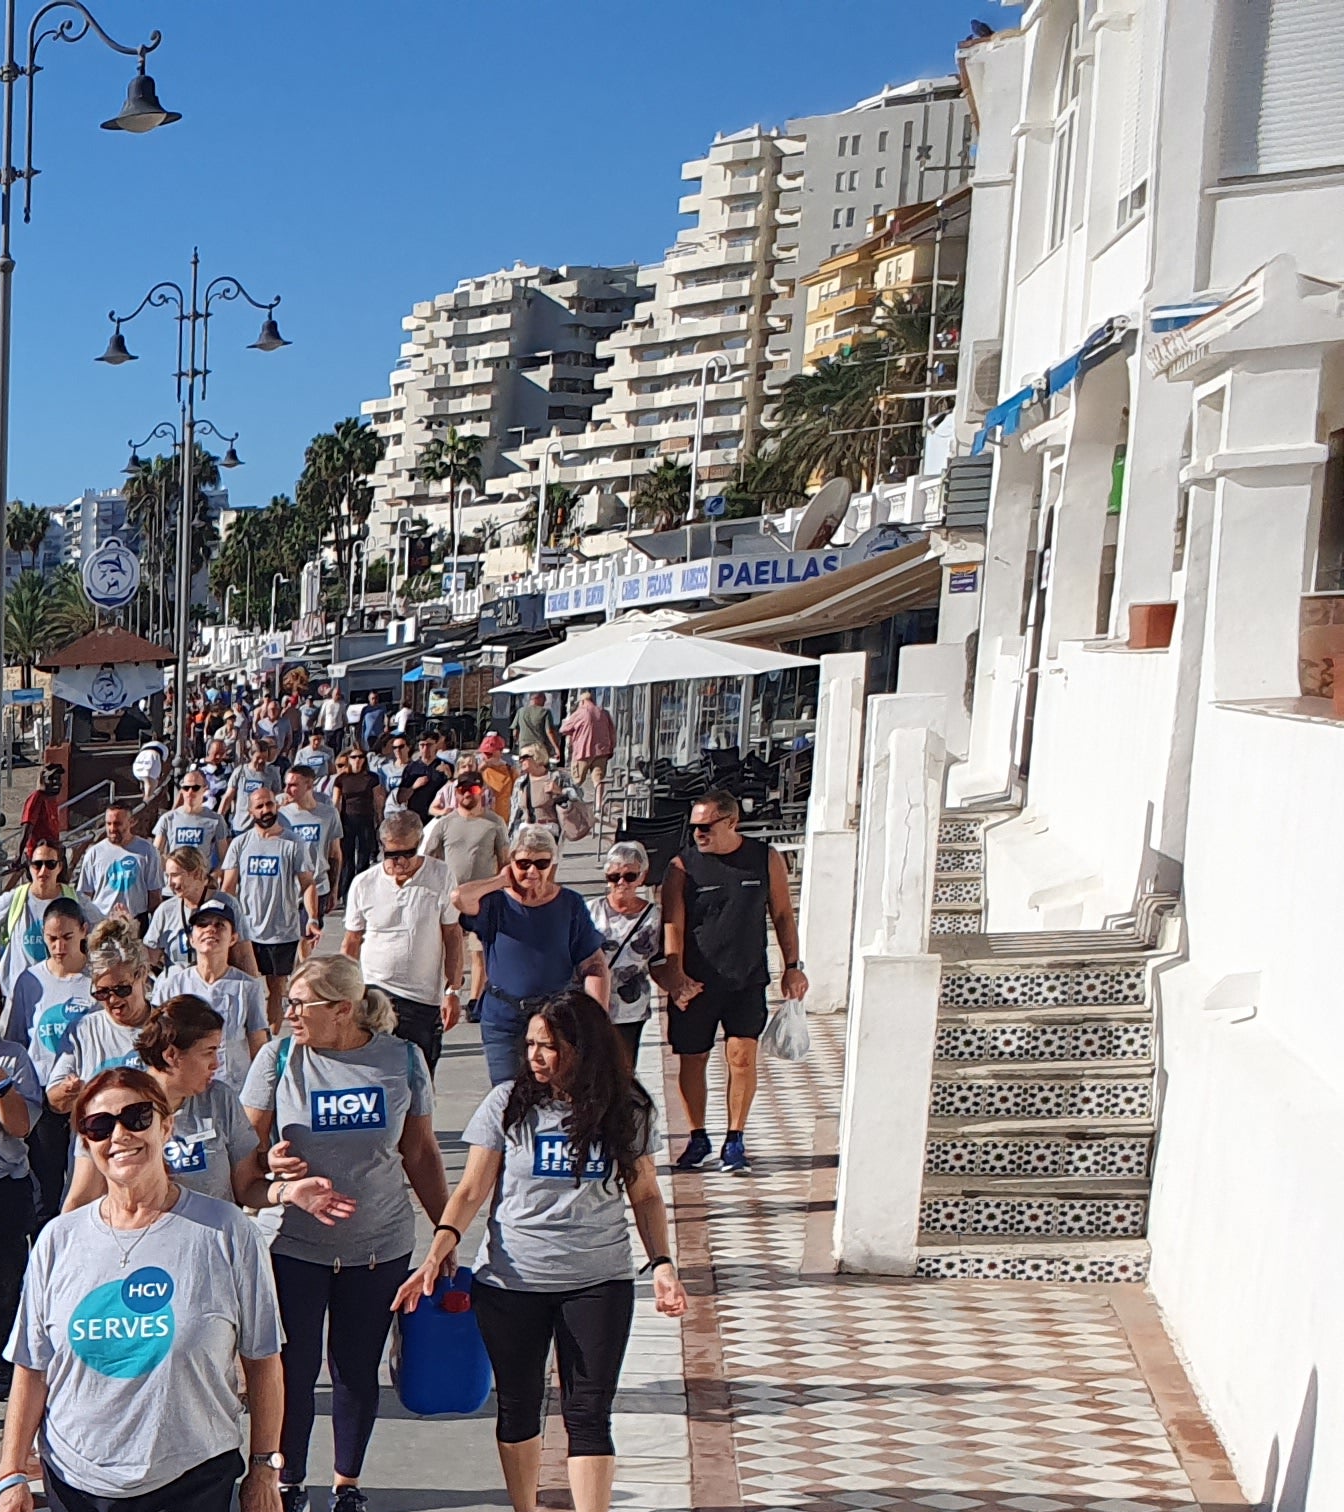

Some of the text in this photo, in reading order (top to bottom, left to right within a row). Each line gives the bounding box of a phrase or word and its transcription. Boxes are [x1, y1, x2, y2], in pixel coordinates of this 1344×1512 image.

[717, 555, 840, 588] PAELLAS
[249, 857, 277, 870] HGV
[23, 935, 43, 945] SER
[64, 1004, 85, 1014] HGV
[317, 1092, 378, 1116] HGV
[318, 1112, 381, 1126] SERVES
[162, 1141, 195, 1161] GV
[540, 1160, 605, 1173] SERES
[128, 1282, 168, 1298] HGV
[72, 1315, 169, 1341] SERVES
